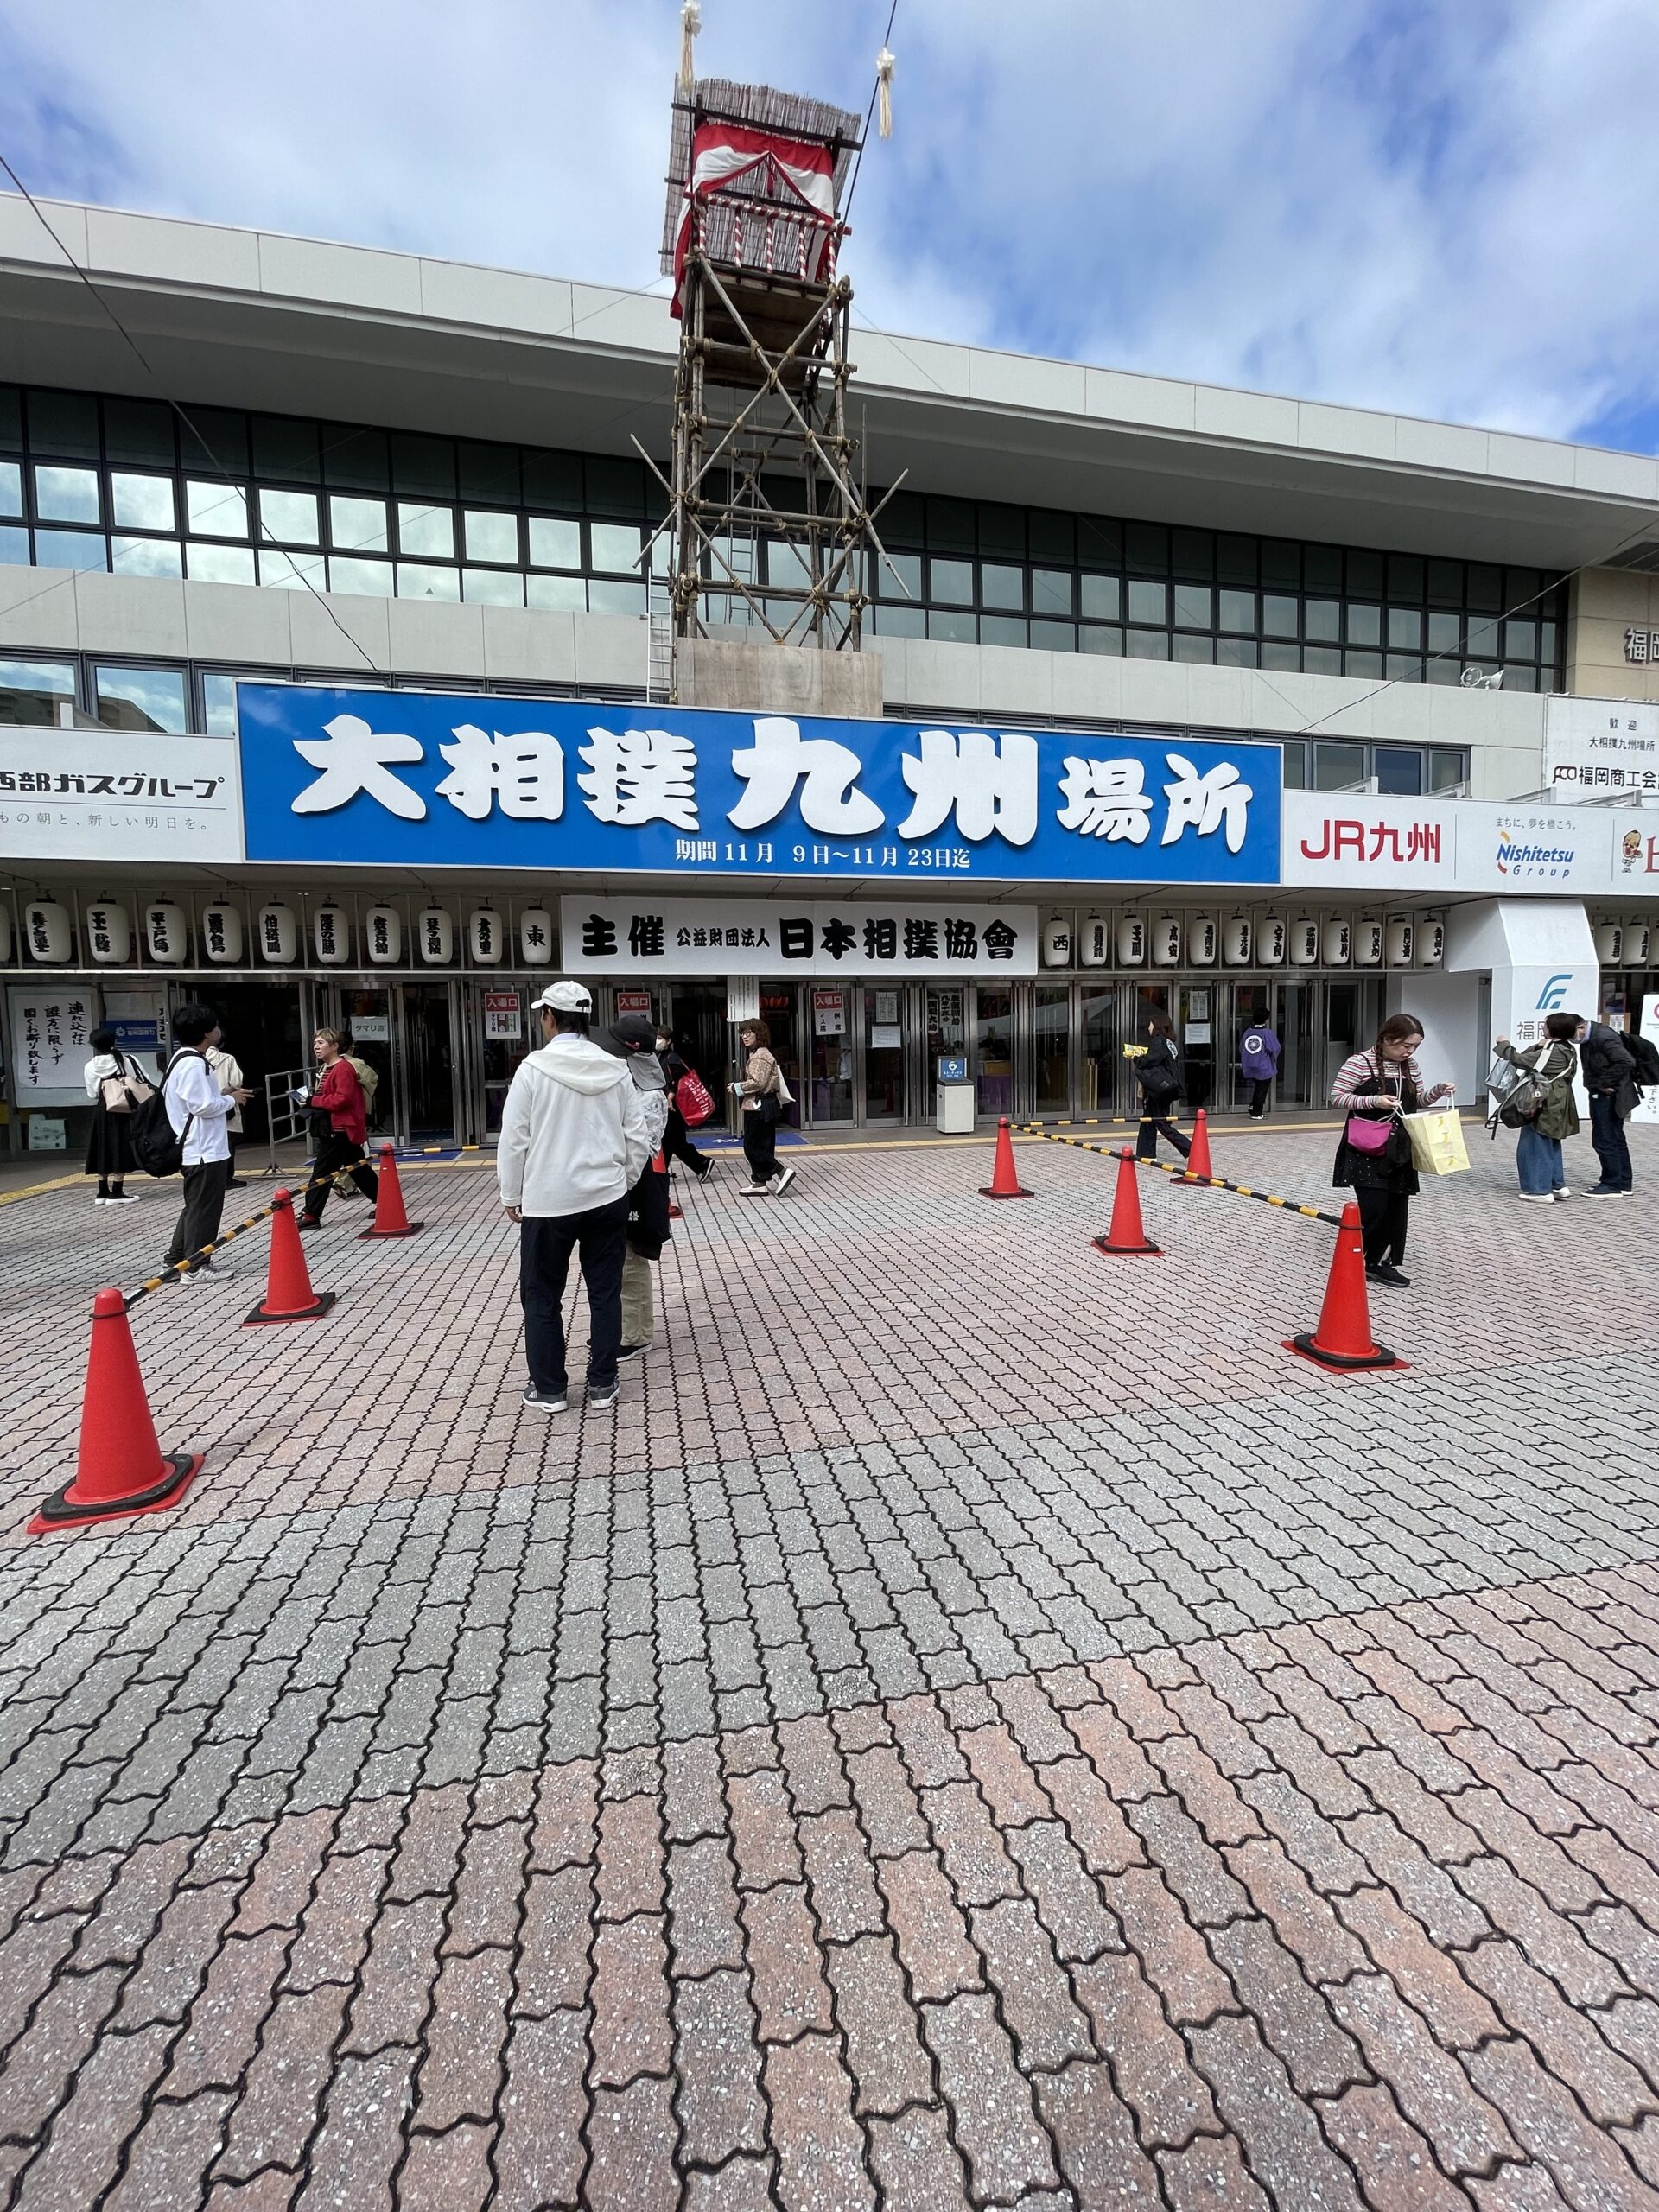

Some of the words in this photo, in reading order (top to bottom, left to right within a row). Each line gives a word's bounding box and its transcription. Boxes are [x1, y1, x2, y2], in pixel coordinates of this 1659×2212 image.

[1589, 736, 1656, 753] 大相撲九州場所
[290, 714, 1254, 854] 大相撲九州場所
[1579, 766, 1659, 791] 福岡商工会
[1300, 819, 1441, 864] JR九州
[1496, 843, 1574, 862] Nishitetsu
[1513, 865, 1570, 879] Group
[477, 918, 493, 955] 大の里
[526, 925, 546, 947] 東
[582, 912, 665, 957] 主催
[676, 926, 771, 948] 公益財団法人
[1052, 934, 1069, 951] 西
[487, 996, 518, 1008] 入場口
[620, 996, 649, 1007] 入場口
[816, 995, 842, 1007] 入場口
